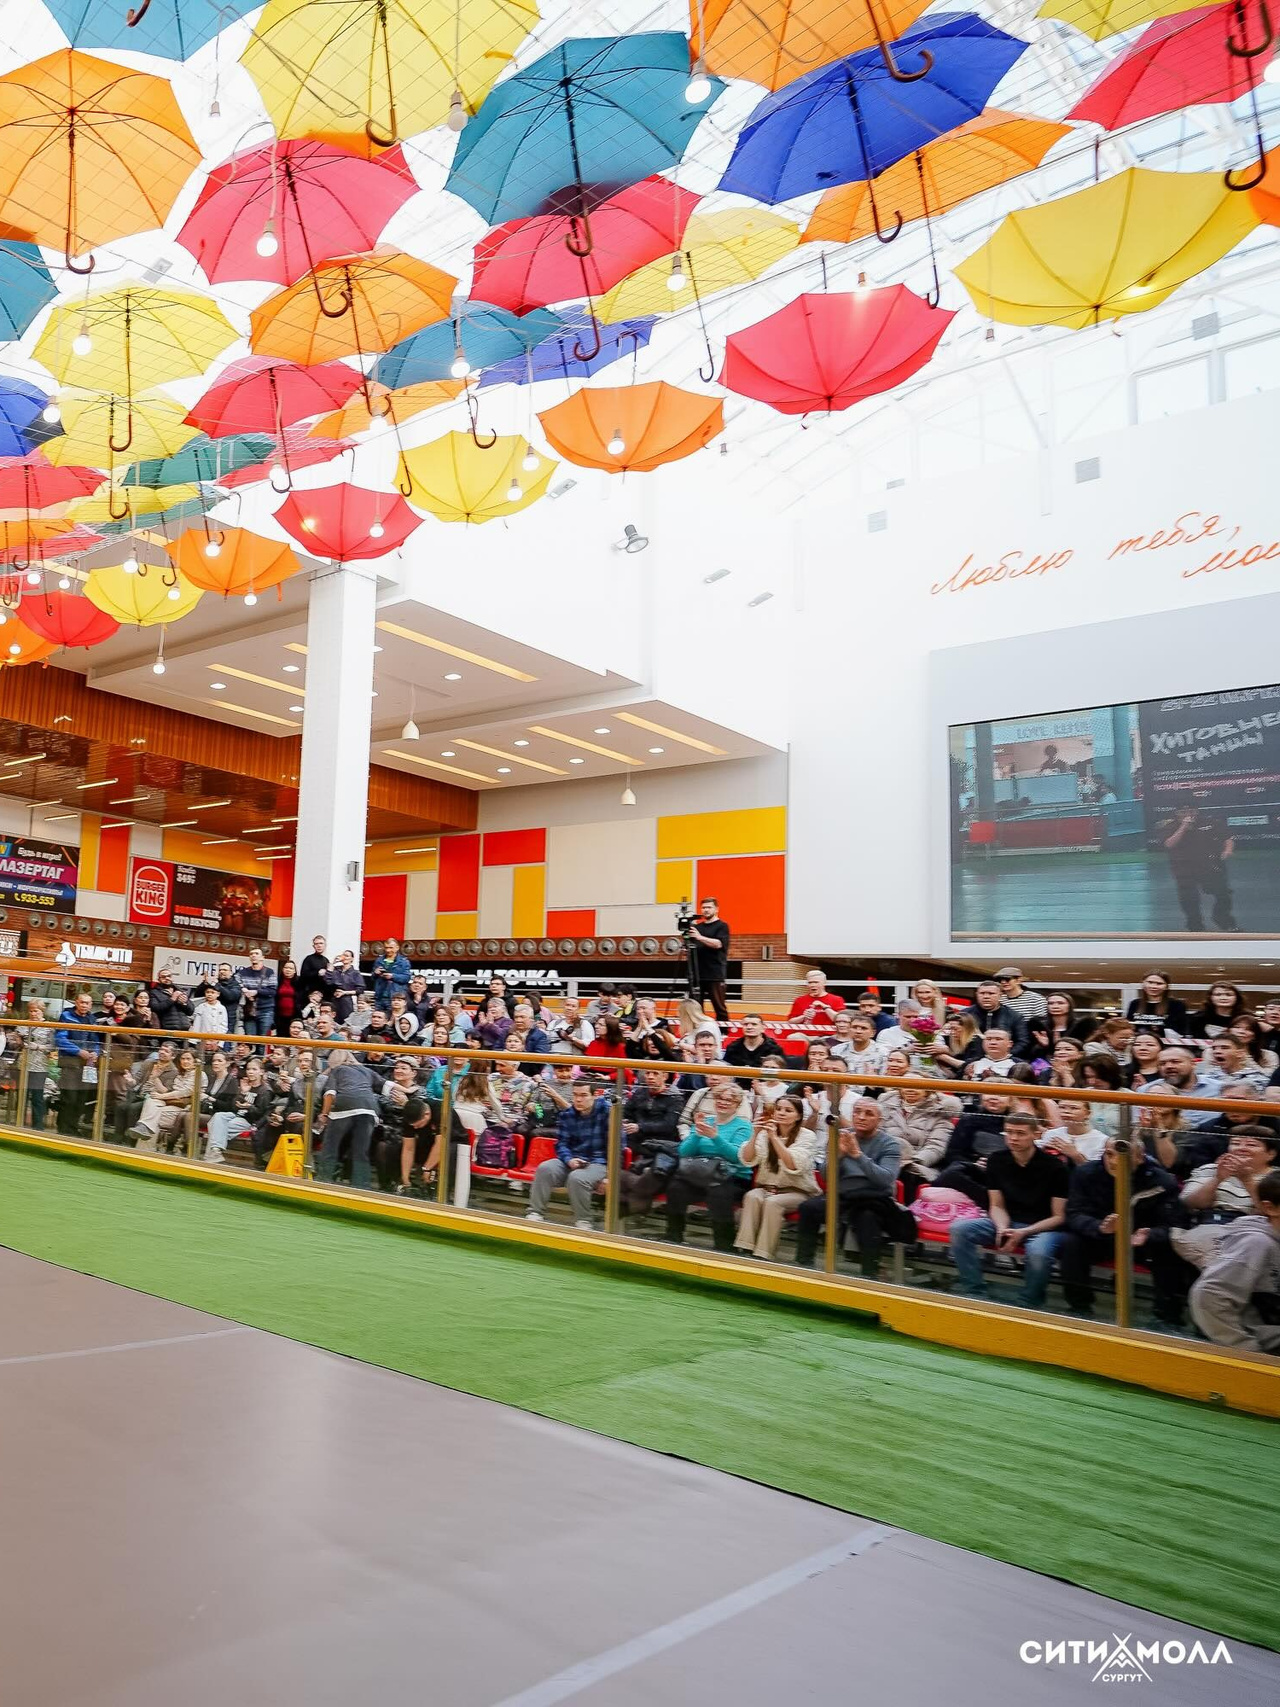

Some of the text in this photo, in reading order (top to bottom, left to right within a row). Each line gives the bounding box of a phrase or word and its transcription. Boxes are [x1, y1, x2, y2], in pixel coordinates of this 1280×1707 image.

[931, 511, 1241, 595] Люблю тебя,
[136, 880, 165, 893] BURGER
[21, 893, 56, 906] 933-553
[136, 889, 165, 906] KING
